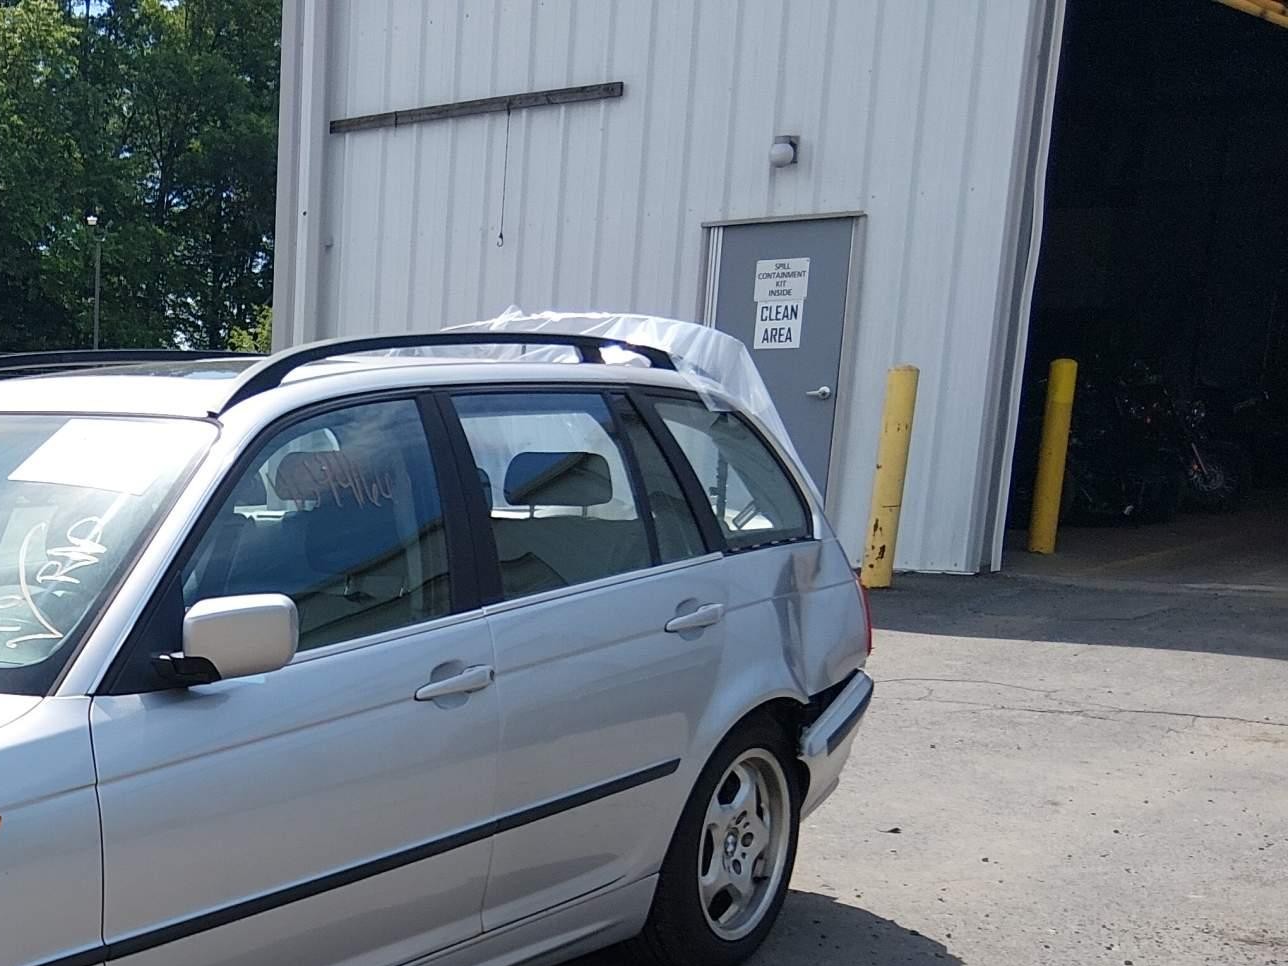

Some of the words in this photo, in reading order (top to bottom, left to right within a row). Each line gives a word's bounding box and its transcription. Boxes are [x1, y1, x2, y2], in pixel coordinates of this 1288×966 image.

[757, 270, 806, 279] CONTAINMENT
[760, 304, 799, 322] CLEAN
[761, 327, 793, 344] AREA
